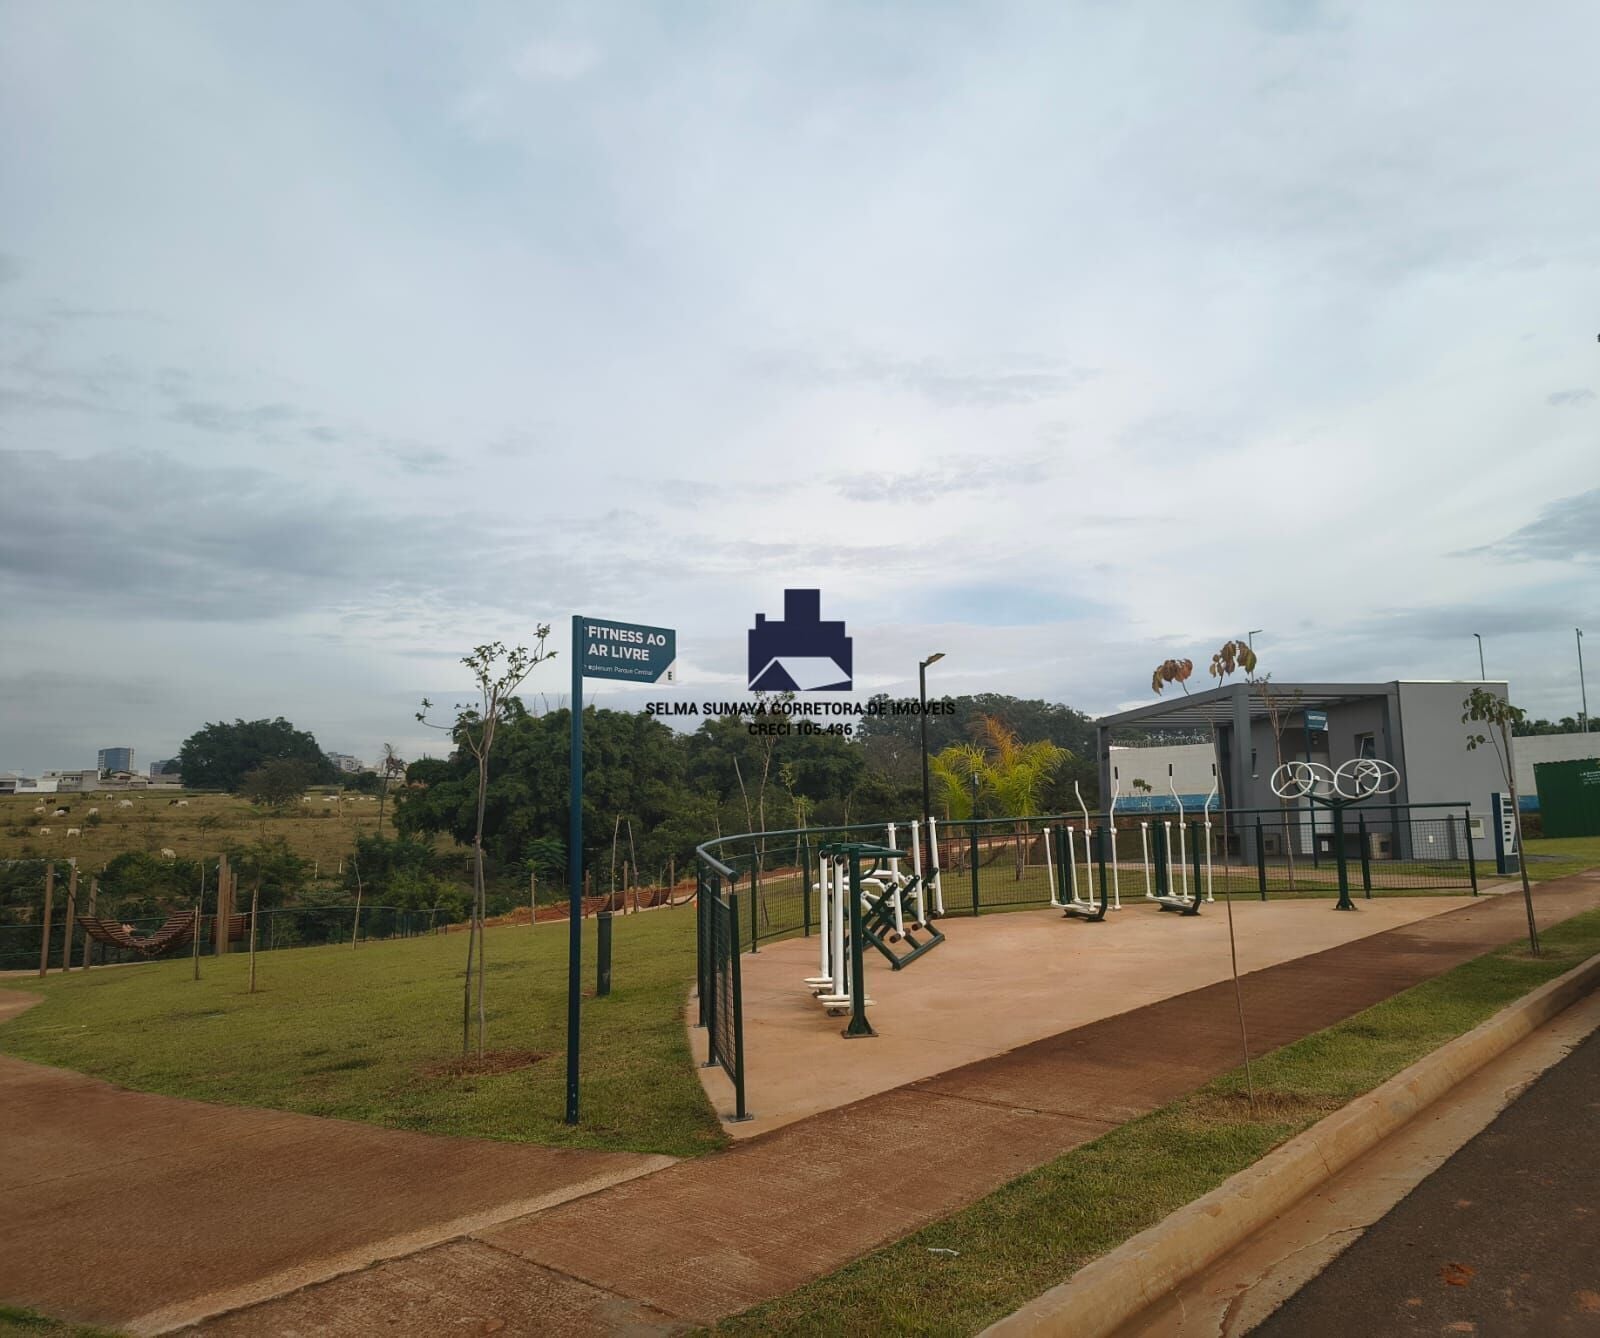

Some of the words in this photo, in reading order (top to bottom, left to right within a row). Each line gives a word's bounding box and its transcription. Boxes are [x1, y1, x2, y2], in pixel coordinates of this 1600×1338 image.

[588, 625, 643, 643] FITNESS
[646, 633, 666, 646] AO
[588, 643, 608, 657] AR
[611, 645, 650, 661] LIVRE
[614, 666, 633, 674] Parque
[668, 671, 673, 681] E
